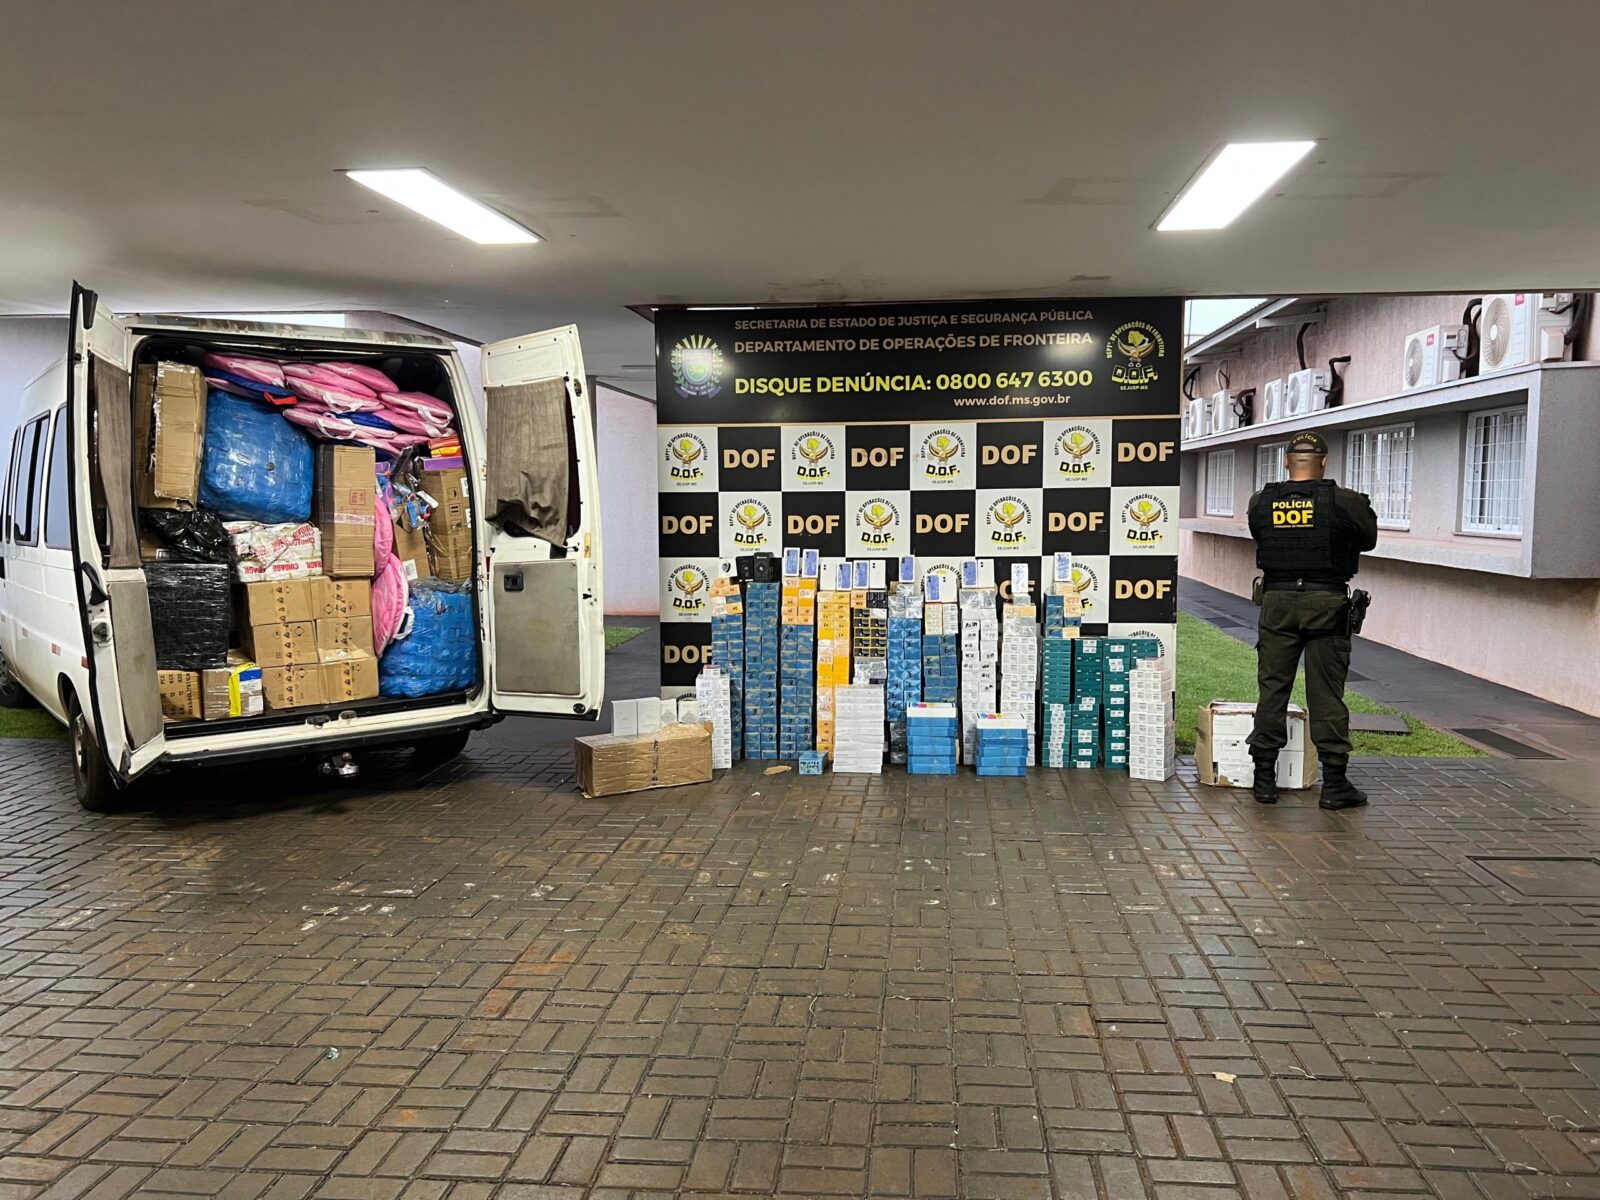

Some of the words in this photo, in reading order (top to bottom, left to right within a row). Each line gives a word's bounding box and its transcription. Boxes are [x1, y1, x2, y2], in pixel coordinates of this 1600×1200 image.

[734, 319, 808, 330] SECRETARIA
[810, 318, 826, 328] DE
[829, 317, 877, 328] ESTADO
[879, 316, 895, 326] DE
[897, 315, 947, 327] JUSTIÇA
[950, 315, 958, 324] E
[961, 311, 1038, 324] SEGURANÇA
[1040, 309, 1093, 322] PÚBLICA
[734, 339, 855, 353] DEPARTAMENTO
[859, 339, 880, 351] DE
[883, 333, 976, 351] OPERAÇÕES
[979, 334, 1000, 347] DE
[1004, 332, 1093, 346] FRONTEIRA
[1110, 333, 1117, 341] DE
[1115, 320, 1146, 335] OPERAÇÕES
[1145, 324, 1153, 332] DE
[1151, 329, 1165, 357] FRONTEIRA
[735, 377, 812, 396] DISQUE
[816, 372, 932, 393] DENÚNCIA:
[936, 373, 992, 390] 0800
[996, 371, 1034, 388] 647
[1038, 370, 1093, 387] 6300
[954, 394, 1071, 407] www.dof.ms.gov.br
[724, 448, 776, 468] DOF
[851, 447, 904, 467] DOF
[982, 445, 1037, 465] DOF
[1118, 441, 1174, 462] DOF
[670, 467, 703, 478] D.O.F.
[797, 466, 830, 477] D.O.F.
[926, 464, 960, 476] D.O.F.
[1059, 461, 1095, 473] D.O.F.
[1272, 500, 1313, 509] POLÍCIA
[662, 515, 713, 535] DOF
[787, 515, 840, 534] DOF
[916, 514, 969, 533] DOF
[1048, 512, 1104, 532] DOF
[1273, 510, 1313, 524] DOF
[734, 532, 767, 544] D.O.F.
[861, 532, 895, 543] D.O.F.
[991, 531, 1026, 542] D.O.F.
[1127, 529, 1163, 541] D.O.F.
[1115, 579, 1171, 599] DOF
[673, 597, 705, 609] D.O.F.
[664, 645, 712, 663] DOF
